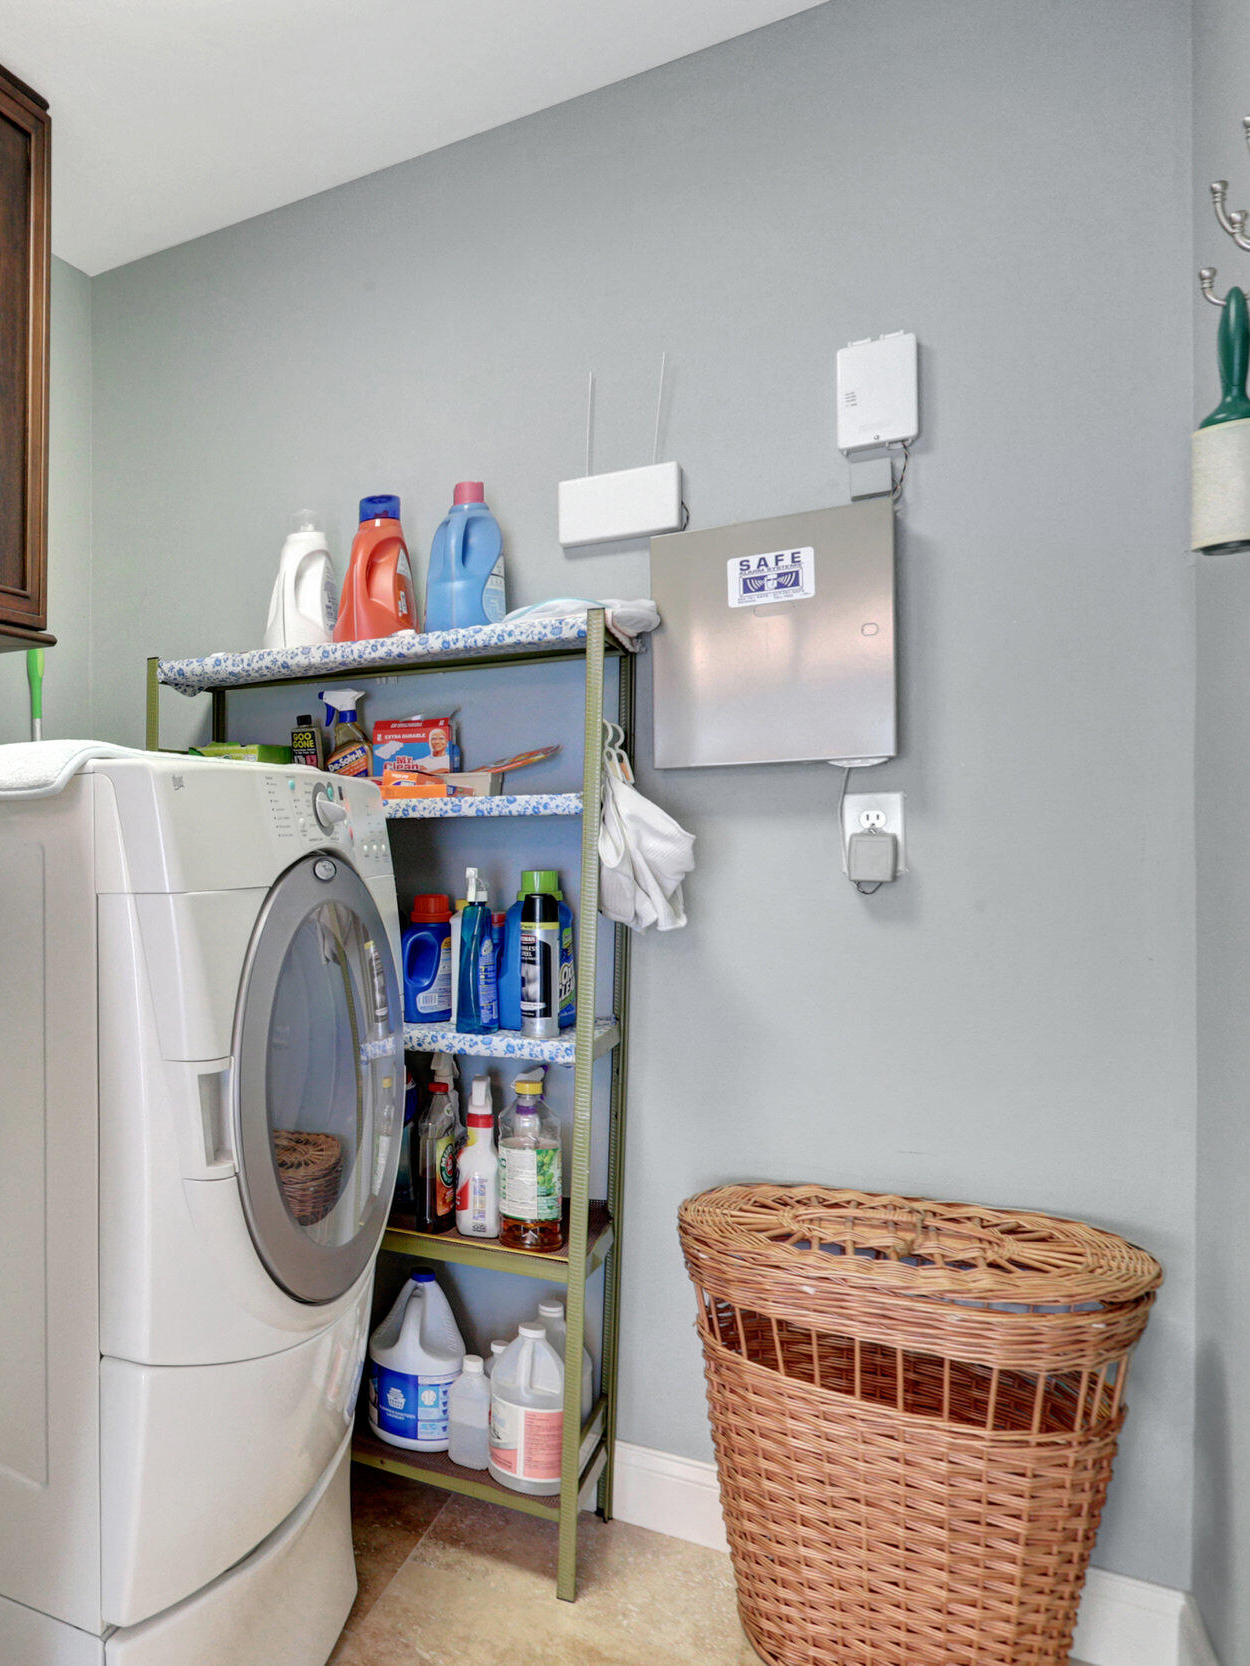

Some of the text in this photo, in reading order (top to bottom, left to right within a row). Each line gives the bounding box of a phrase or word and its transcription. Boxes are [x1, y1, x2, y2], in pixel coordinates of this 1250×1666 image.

[739, 551, 801, 571] SAFE
[293, 732, 312, 741] GOO
[293, 740, 315, 748] GONE
[383, 761, 419, 771] Clean
